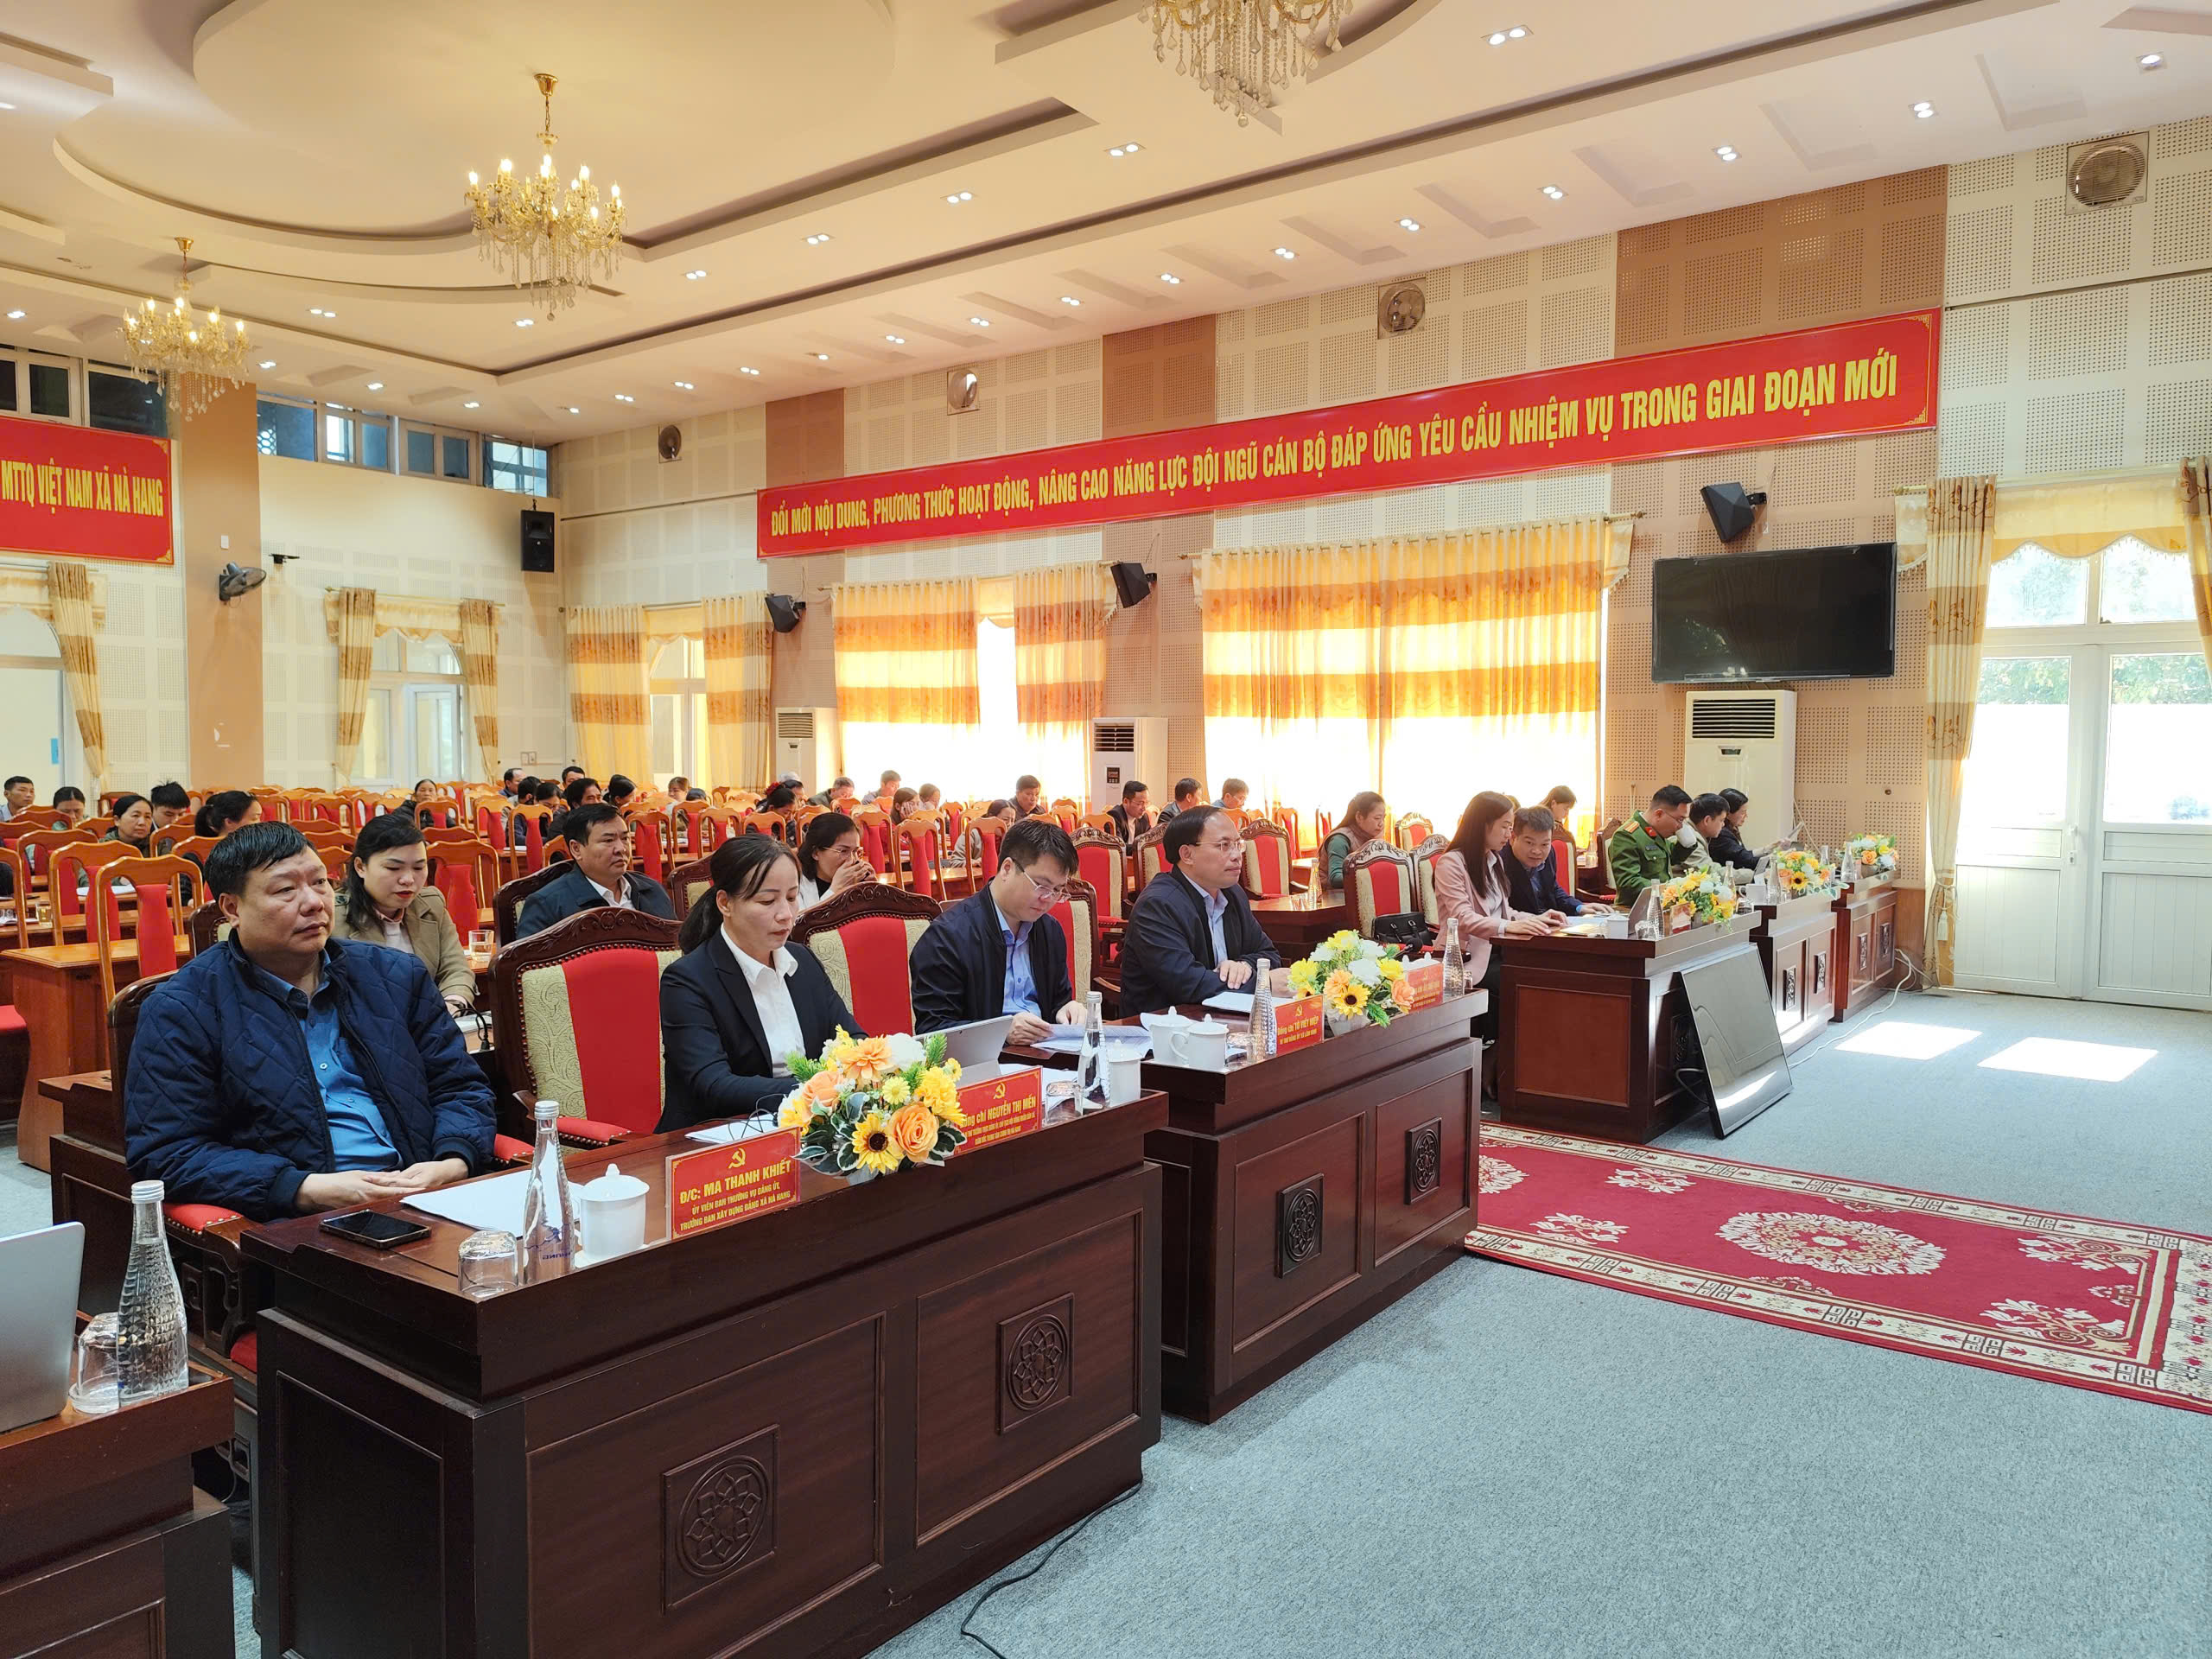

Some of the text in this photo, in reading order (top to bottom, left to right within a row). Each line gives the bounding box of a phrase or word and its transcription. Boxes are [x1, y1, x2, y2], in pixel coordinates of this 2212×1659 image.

[772, 348, 1897, 536] ĐỔI MỚI NỘI DUNG, PHƯƠNG THỨC HOẠT ĐỘNG, NÂNG CAO NĂNG LỰC ĐỘI NGŨ CÁN BỘ ĐÁP ỨNG YÊU CẦU NHIỆM VỤ TRONG GIAI ĐOẠN MỚI
[1, 457, 163, 516] MTTQ VIỆT NAM XÃ NÀ HANG
[976, 1109, 987, 1123] chí
[680, 1158, 791, 1205] Đ/C: MA THANH KHIẾT
[701, 1201, 714, 1212] VIÊN
[715, 1198, 726, 1207] BAN
[750, 1189, 757, 1198] VỤ
[703, 1214, 716, 1224] BAN
